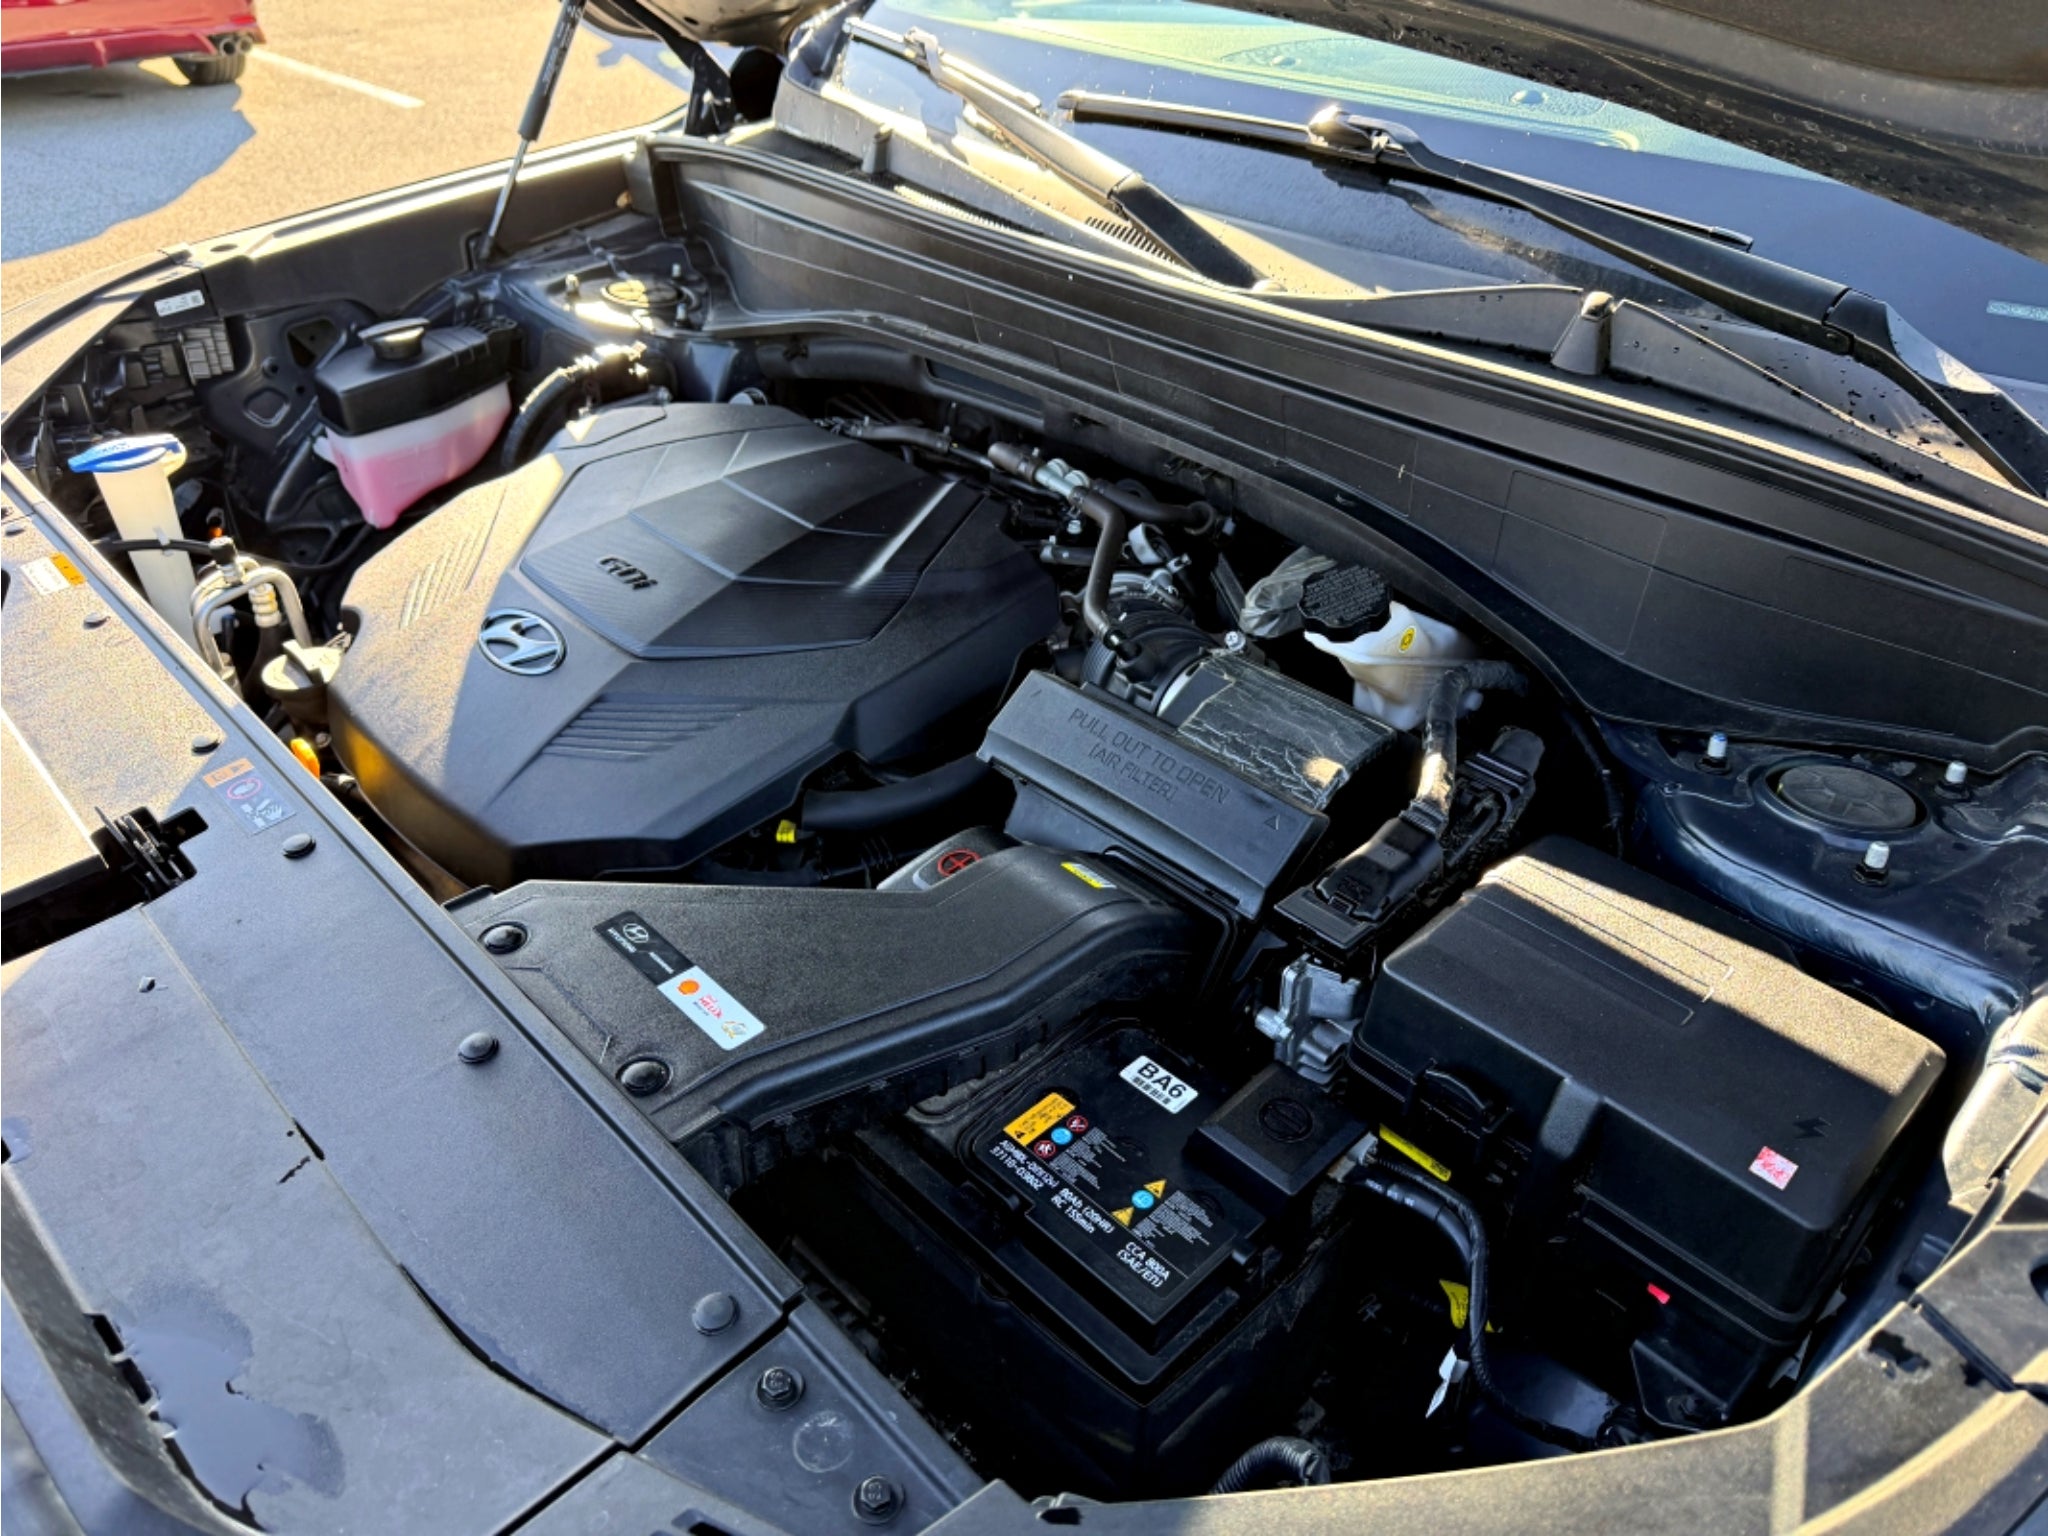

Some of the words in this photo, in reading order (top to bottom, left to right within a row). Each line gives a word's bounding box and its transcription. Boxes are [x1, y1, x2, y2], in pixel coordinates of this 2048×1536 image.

[1068, 708, 1109, 743] PULL
[1112, 731, 1152, 760] OUT
[1151, 750, 1177, 774] TO
[1175, 765, 1231, 804] OPEN
[1088, 743, 1121, 769] (AIR
[1120, 761, 1178, 801] FILTER)
[1137, 1063, 1187, 1098] BA6
[1125, 1242, 1146, 1260] CCA
